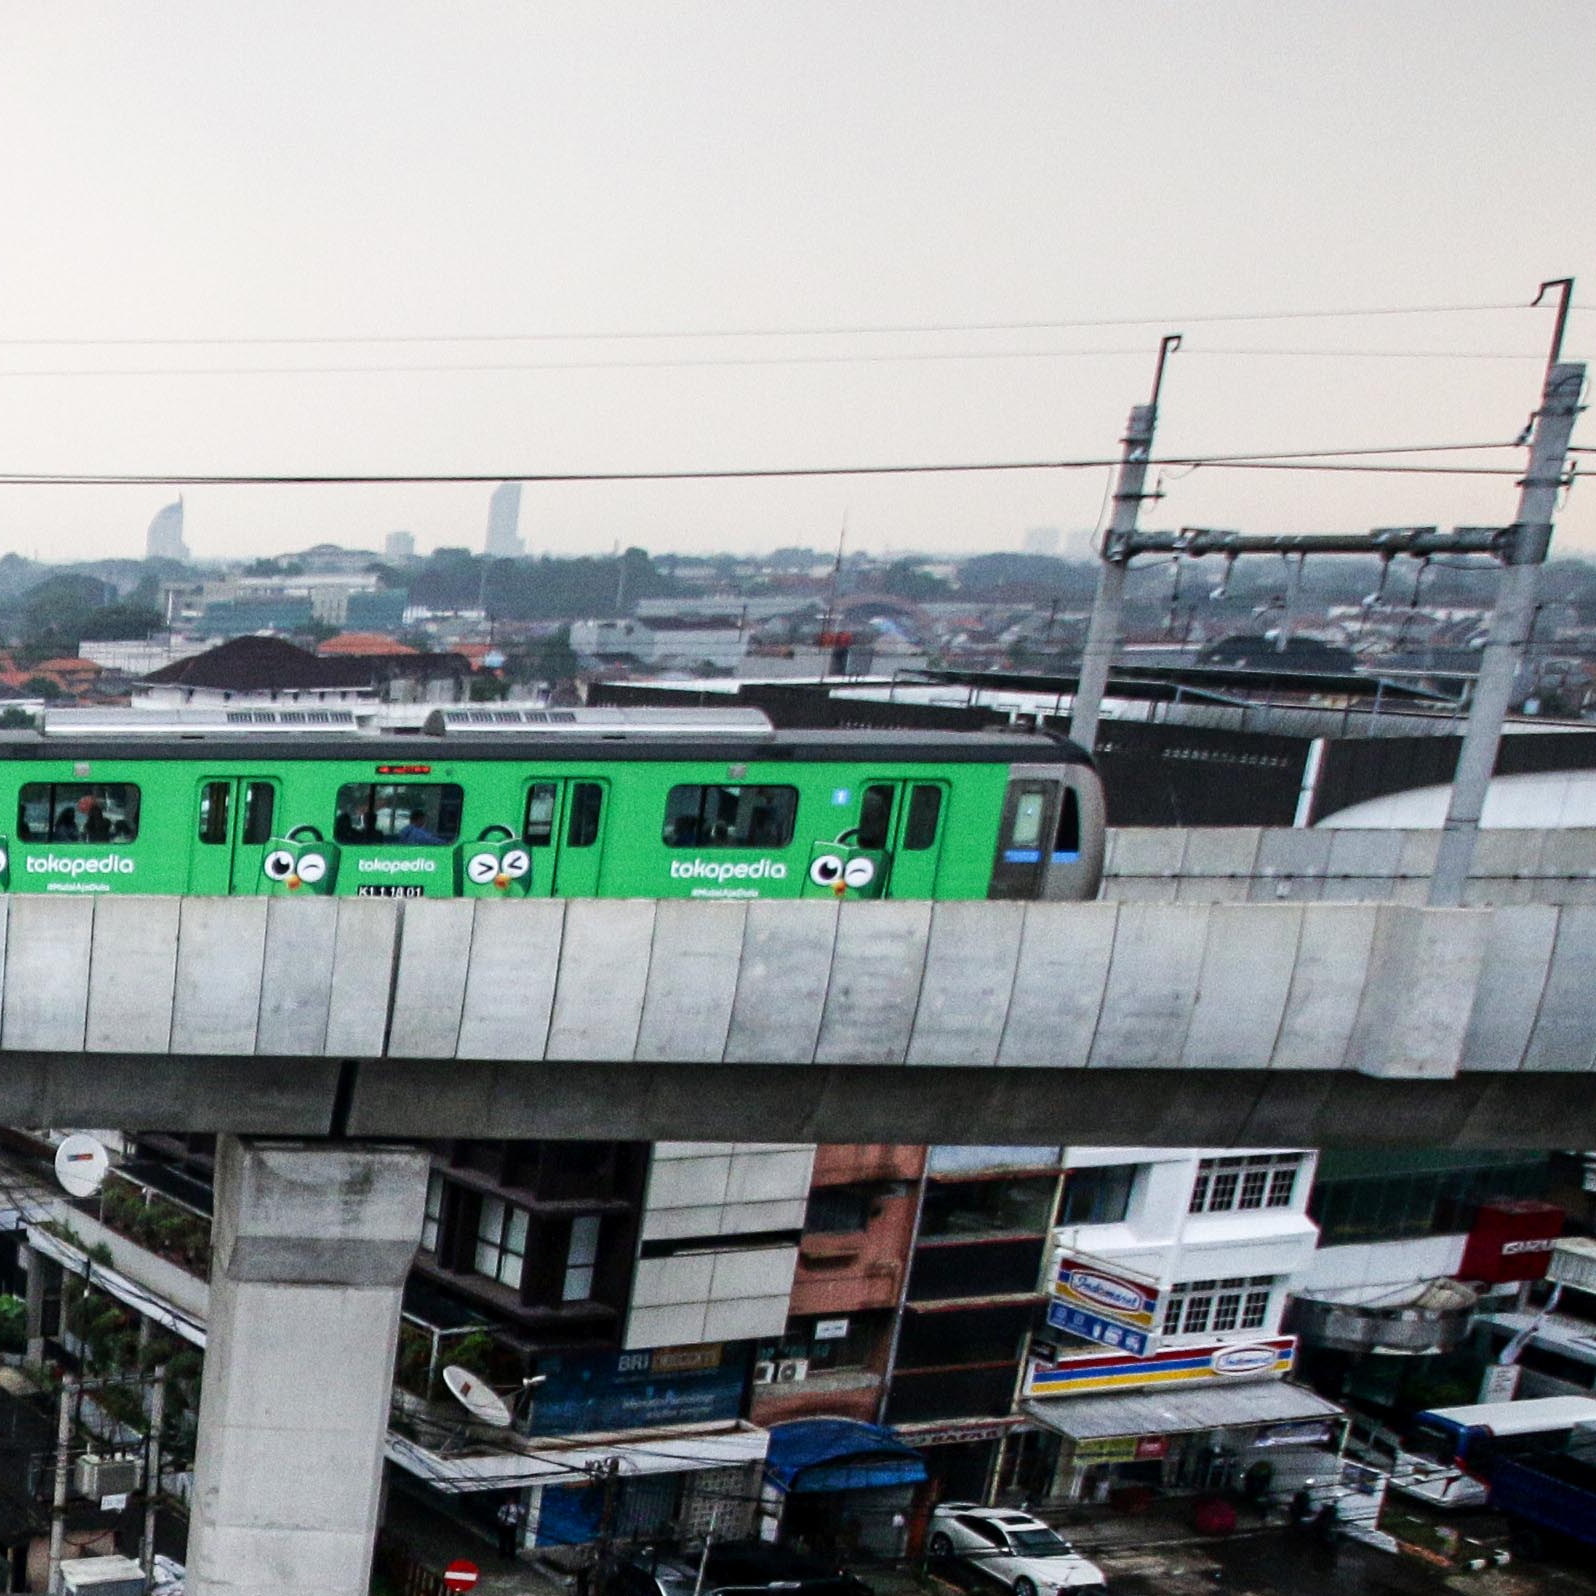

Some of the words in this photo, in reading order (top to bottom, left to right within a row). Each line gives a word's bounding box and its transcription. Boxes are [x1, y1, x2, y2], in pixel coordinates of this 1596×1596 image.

[26, 853, 135, 876] tokopedia
[358, 857, 437, 874] tokopedia
[670, 858, 788, 882] tokopedia
[359, 886, 374, 898] K1
[407, 886, 421, 898] 01
[1075, 1274, 1139, 1308] Indomaret
[617, 1353, 650, 1372] BRI
